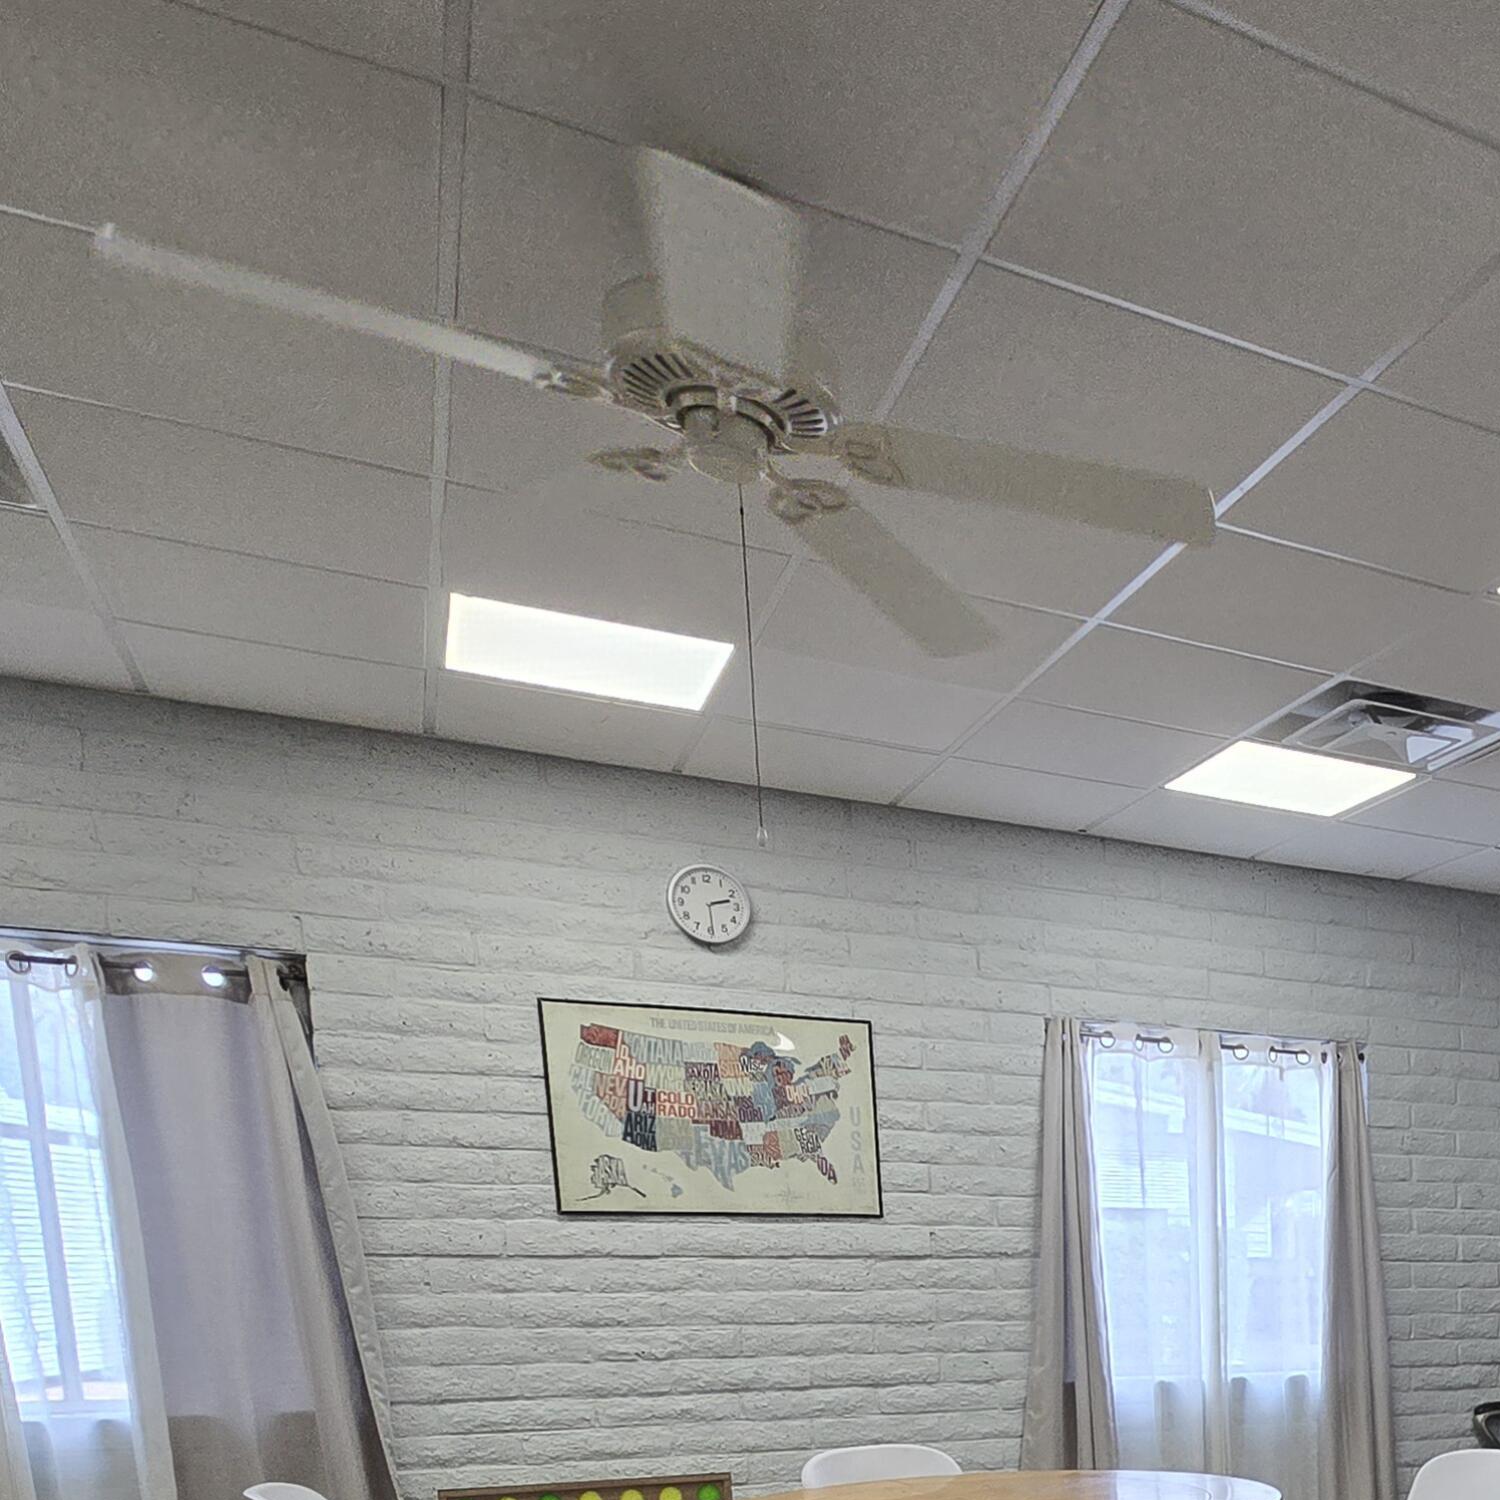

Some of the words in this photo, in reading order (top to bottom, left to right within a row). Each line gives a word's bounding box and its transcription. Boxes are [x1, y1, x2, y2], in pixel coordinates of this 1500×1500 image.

[702, 874, 711, 883] 12
[681, 885, 690, 894] 10
[728, 889, 736, 899] 2
[678, 897, 684, 906] 9
[733, 903, 740, 912] 3
[683, 911, 690, 920] 8
[730, 916, 736, 924] 4
[694, 921, 700, 930] 7
[721, 924, 728, 933] 5
